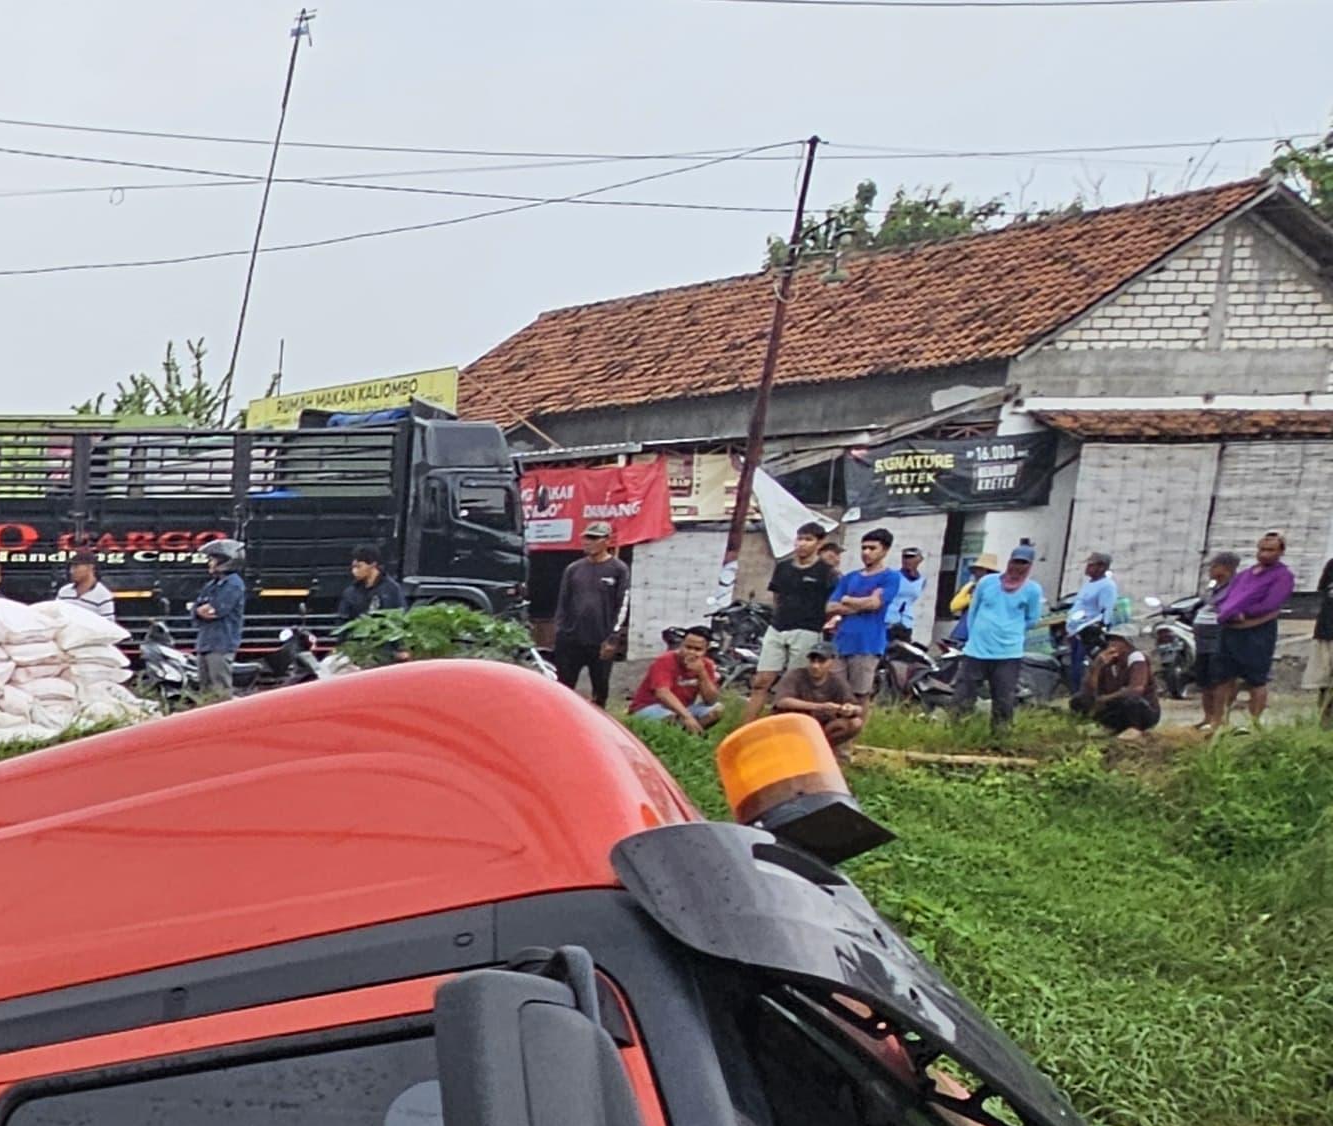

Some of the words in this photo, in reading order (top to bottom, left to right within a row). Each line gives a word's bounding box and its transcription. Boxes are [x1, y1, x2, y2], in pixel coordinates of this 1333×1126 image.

[358, 378, 419, 402] KALIOMBO
[885, 471, 937, 486] KRETEK
[133, 551, 210, 564] Carg
